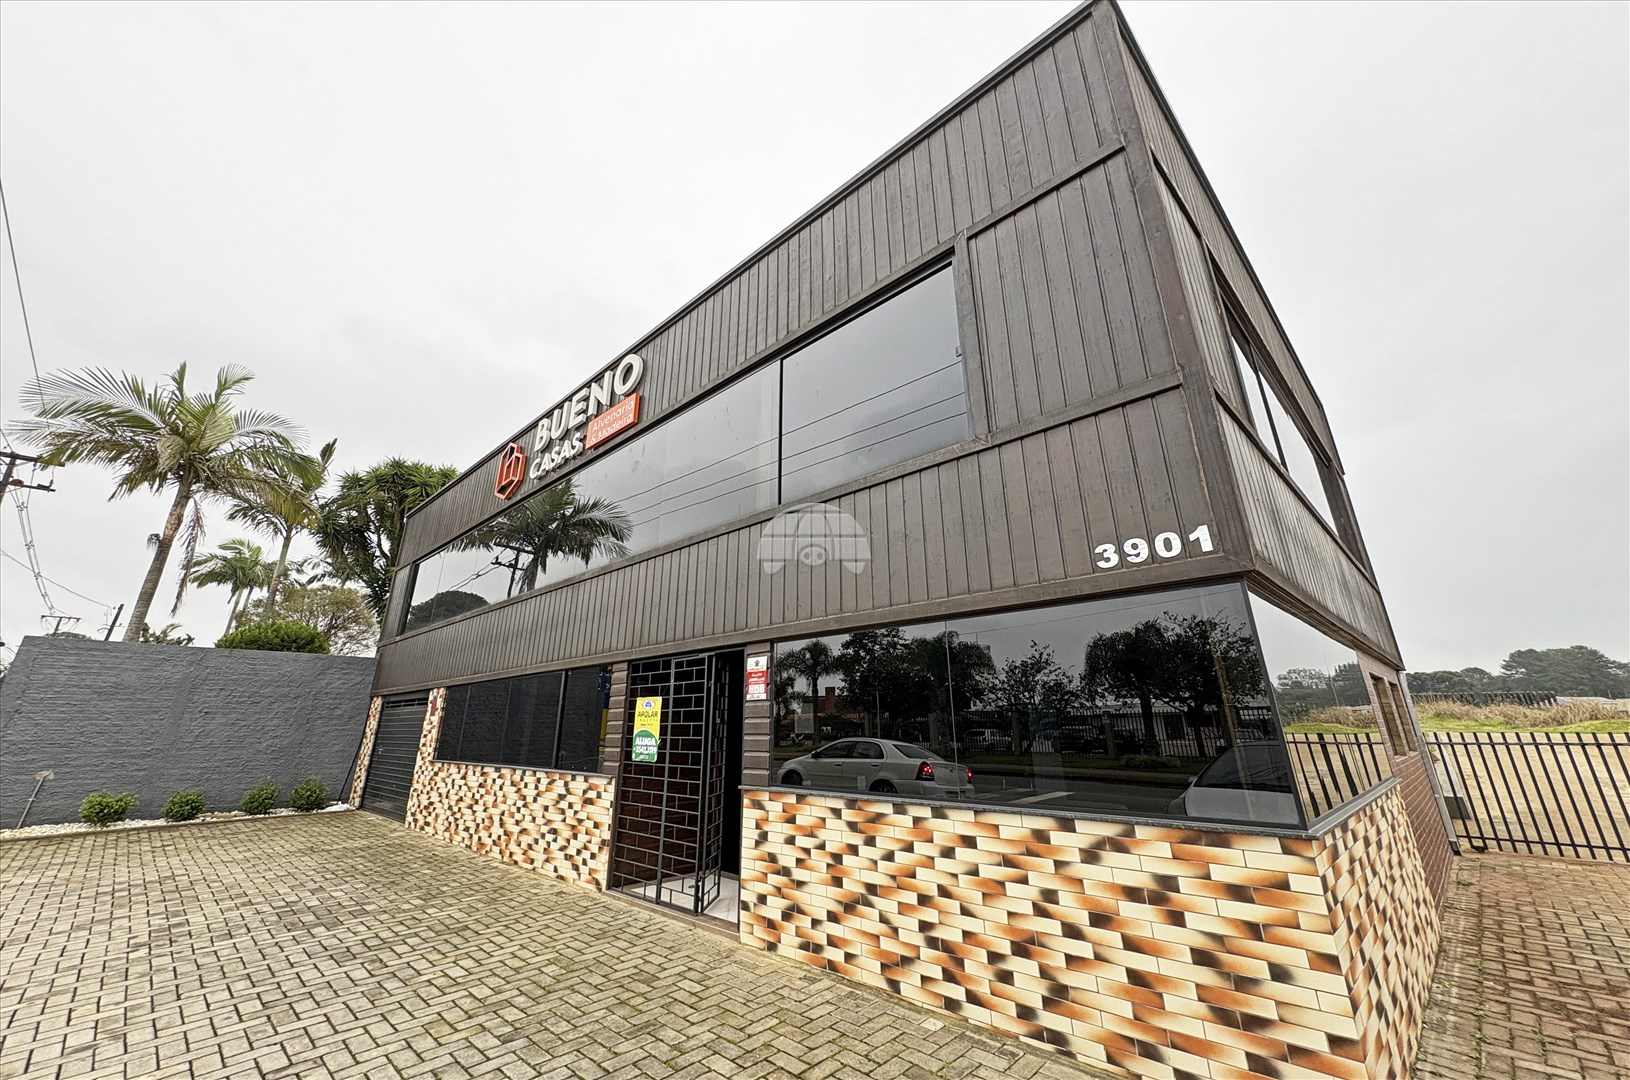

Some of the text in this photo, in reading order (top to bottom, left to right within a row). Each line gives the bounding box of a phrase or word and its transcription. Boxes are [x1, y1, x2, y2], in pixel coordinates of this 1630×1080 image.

[534, 353, 644, 452] BUENO
[592, 400, 634, 432] Alvenaria
[598, 413, 633, 440] Madeira
[529, 432, 584, 480] CASAS
[1094, 524, 1214, 569] 3901
[637, 710, 659, 718] APOLAR
[635, 736, 656, 746] ALUGA
